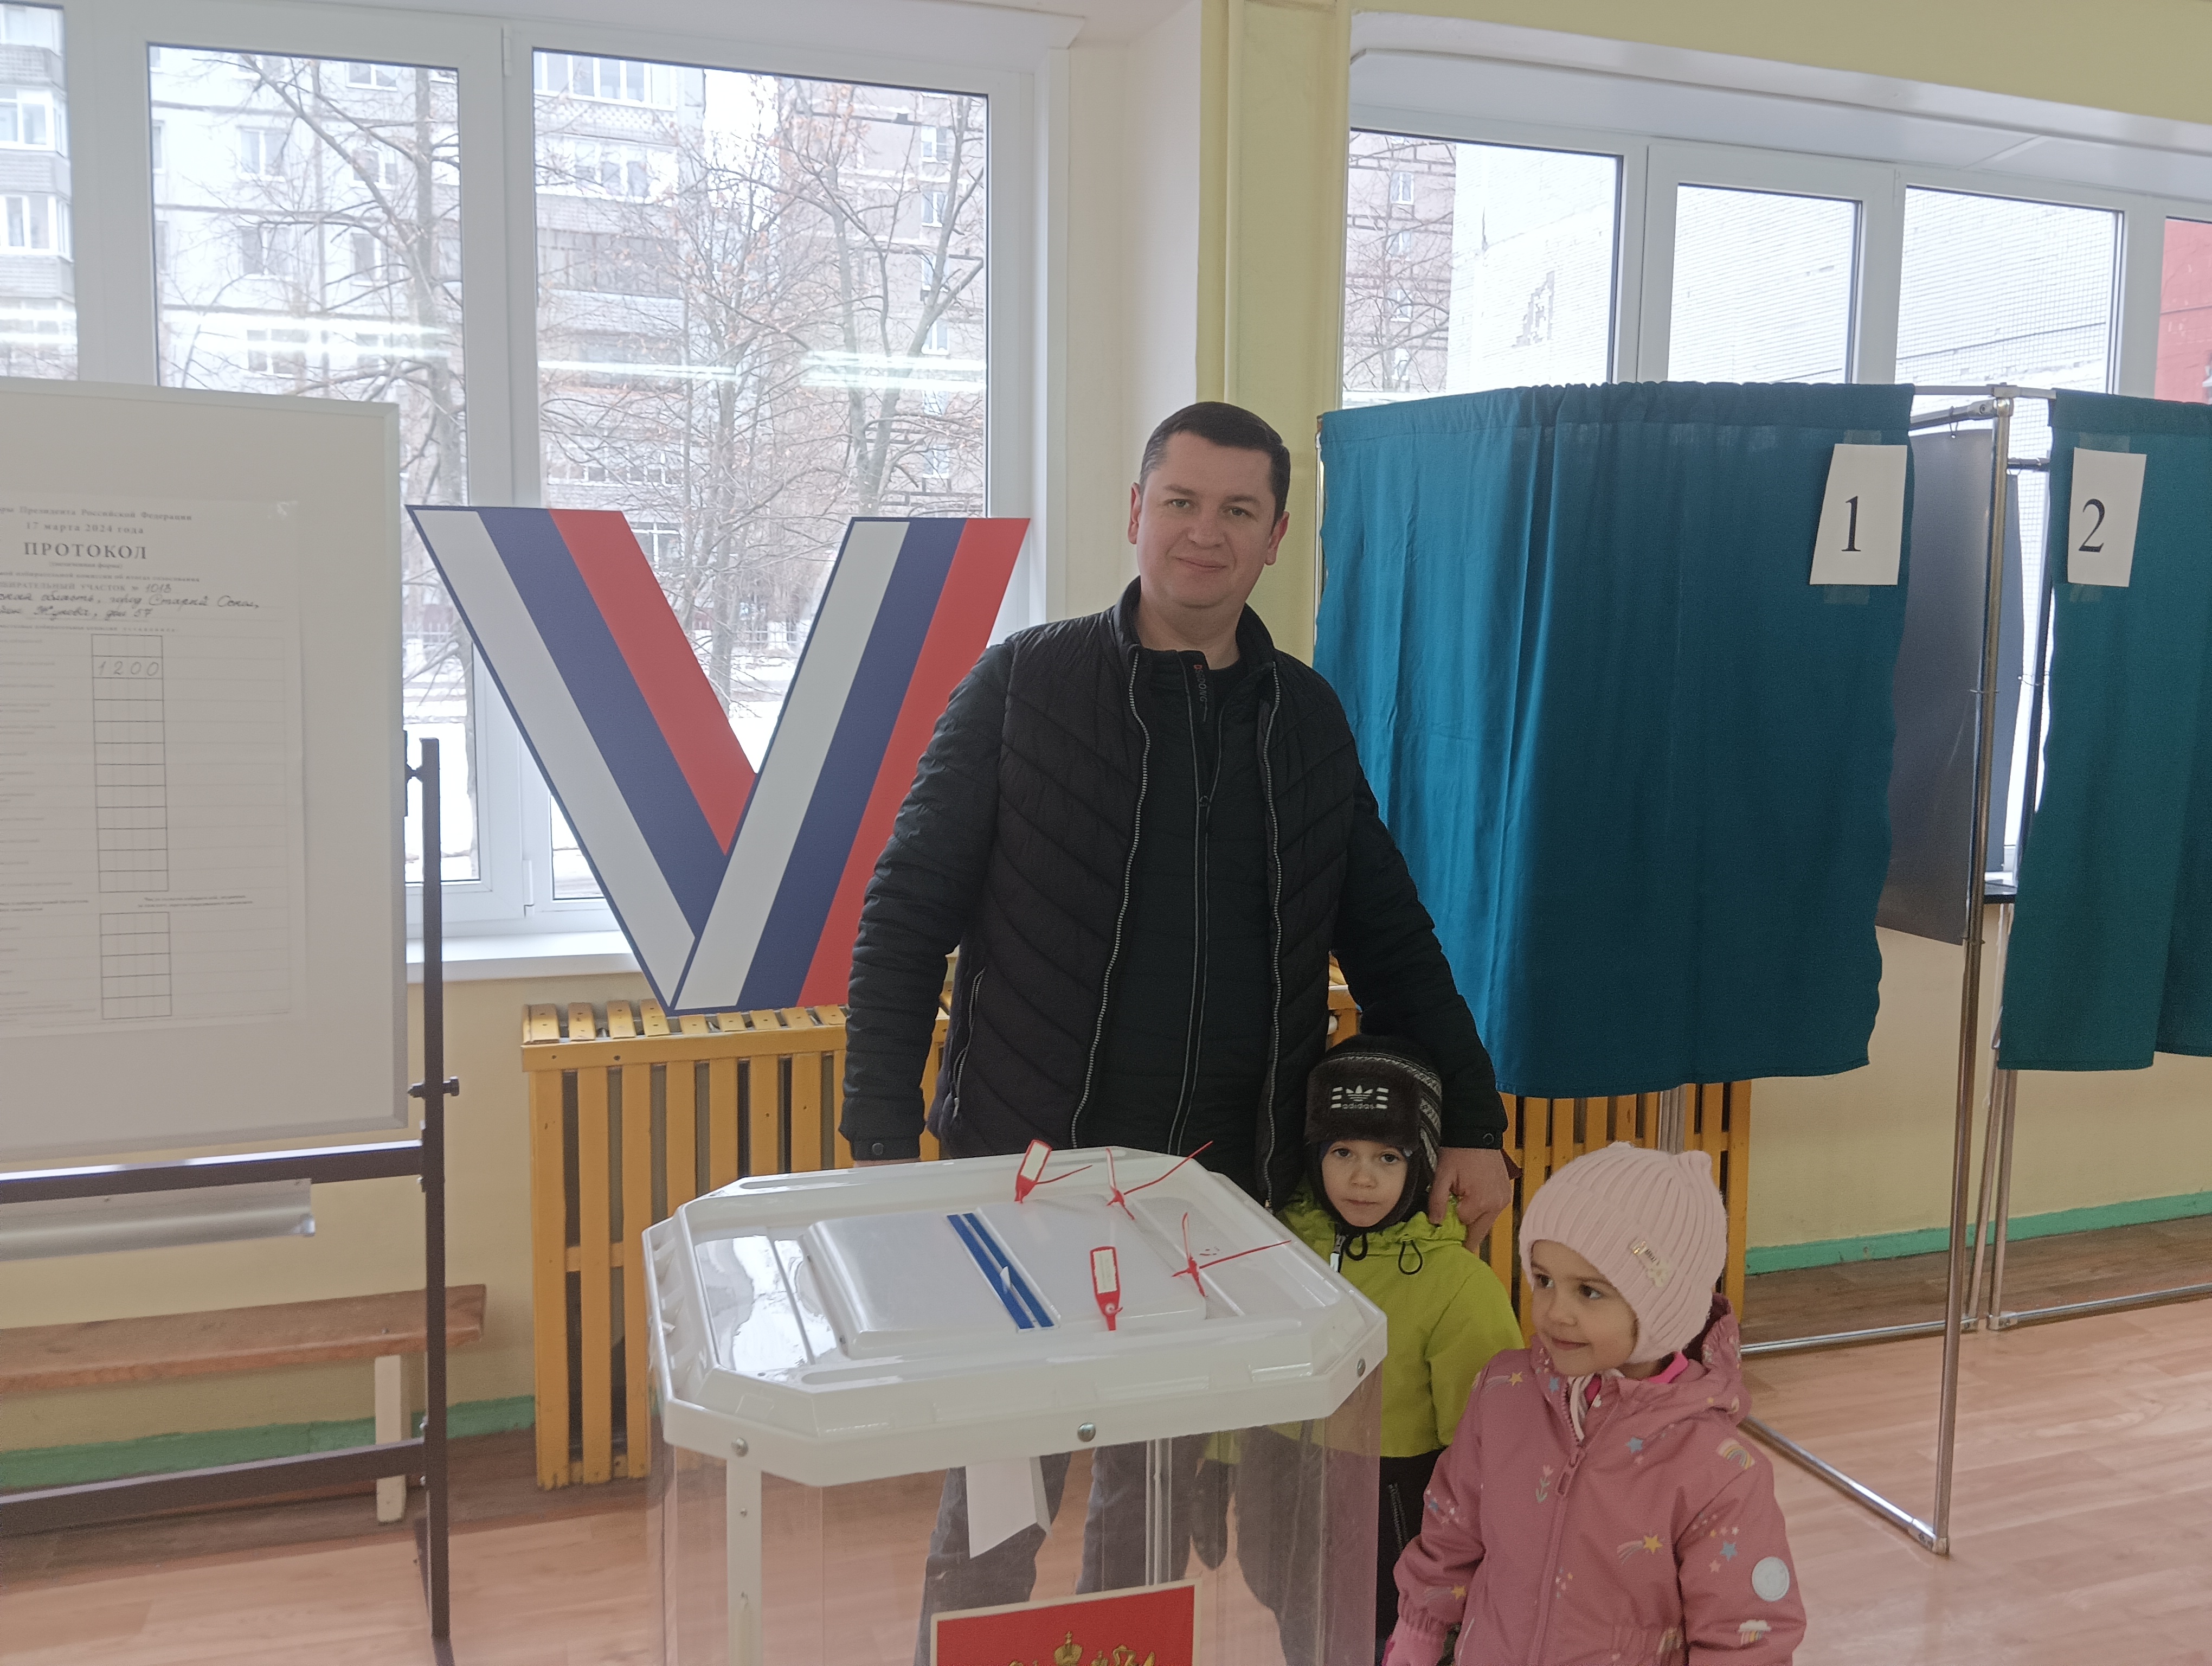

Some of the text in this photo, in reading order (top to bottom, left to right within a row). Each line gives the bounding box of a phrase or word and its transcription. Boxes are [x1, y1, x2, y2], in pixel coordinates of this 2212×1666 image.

[27, 522, 38, 530] 17
[44, 524, 80, 533] марта
[85, 523, 112, 533] 2024
[1841, 496, 1861, 552] 1
[2079, 498, 2106, 553] 2
[23, 542, 147, 560] ПРОТОКОЛ
